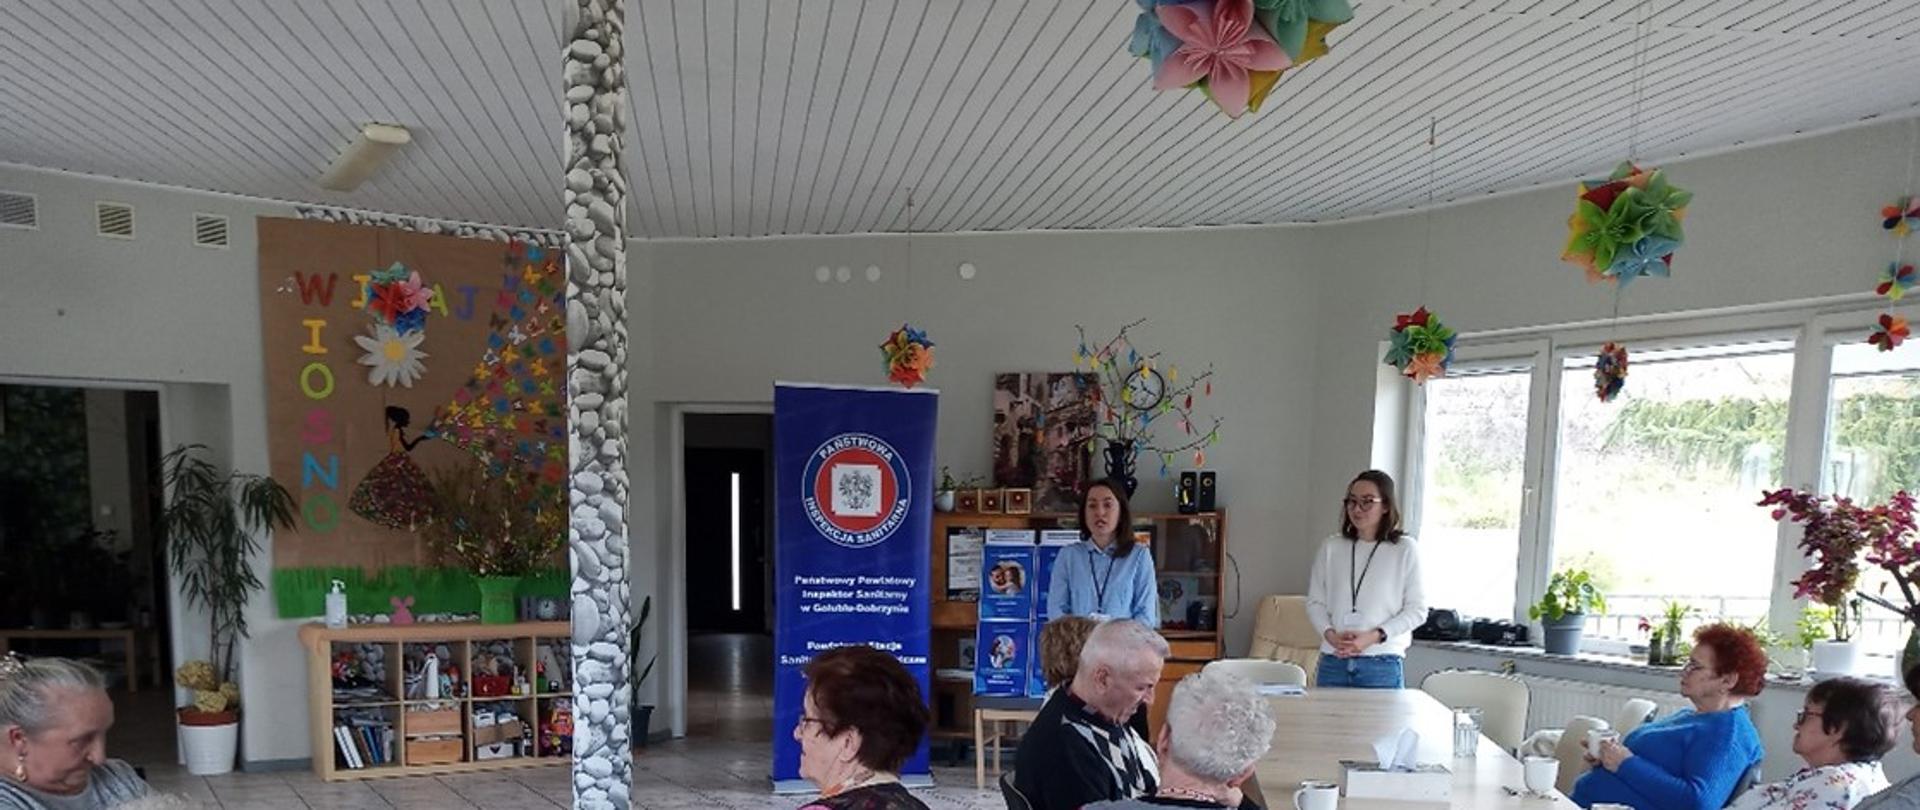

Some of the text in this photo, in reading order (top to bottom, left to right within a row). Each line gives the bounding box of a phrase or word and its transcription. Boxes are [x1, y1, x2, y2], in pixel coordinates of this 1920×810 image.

[294, 270, 480, 322] WIAJ
[805, 497, 908, 543] INSPEKCJA SANITARNA
[802, 590, 908, 602] Inspektor Sanitarny
